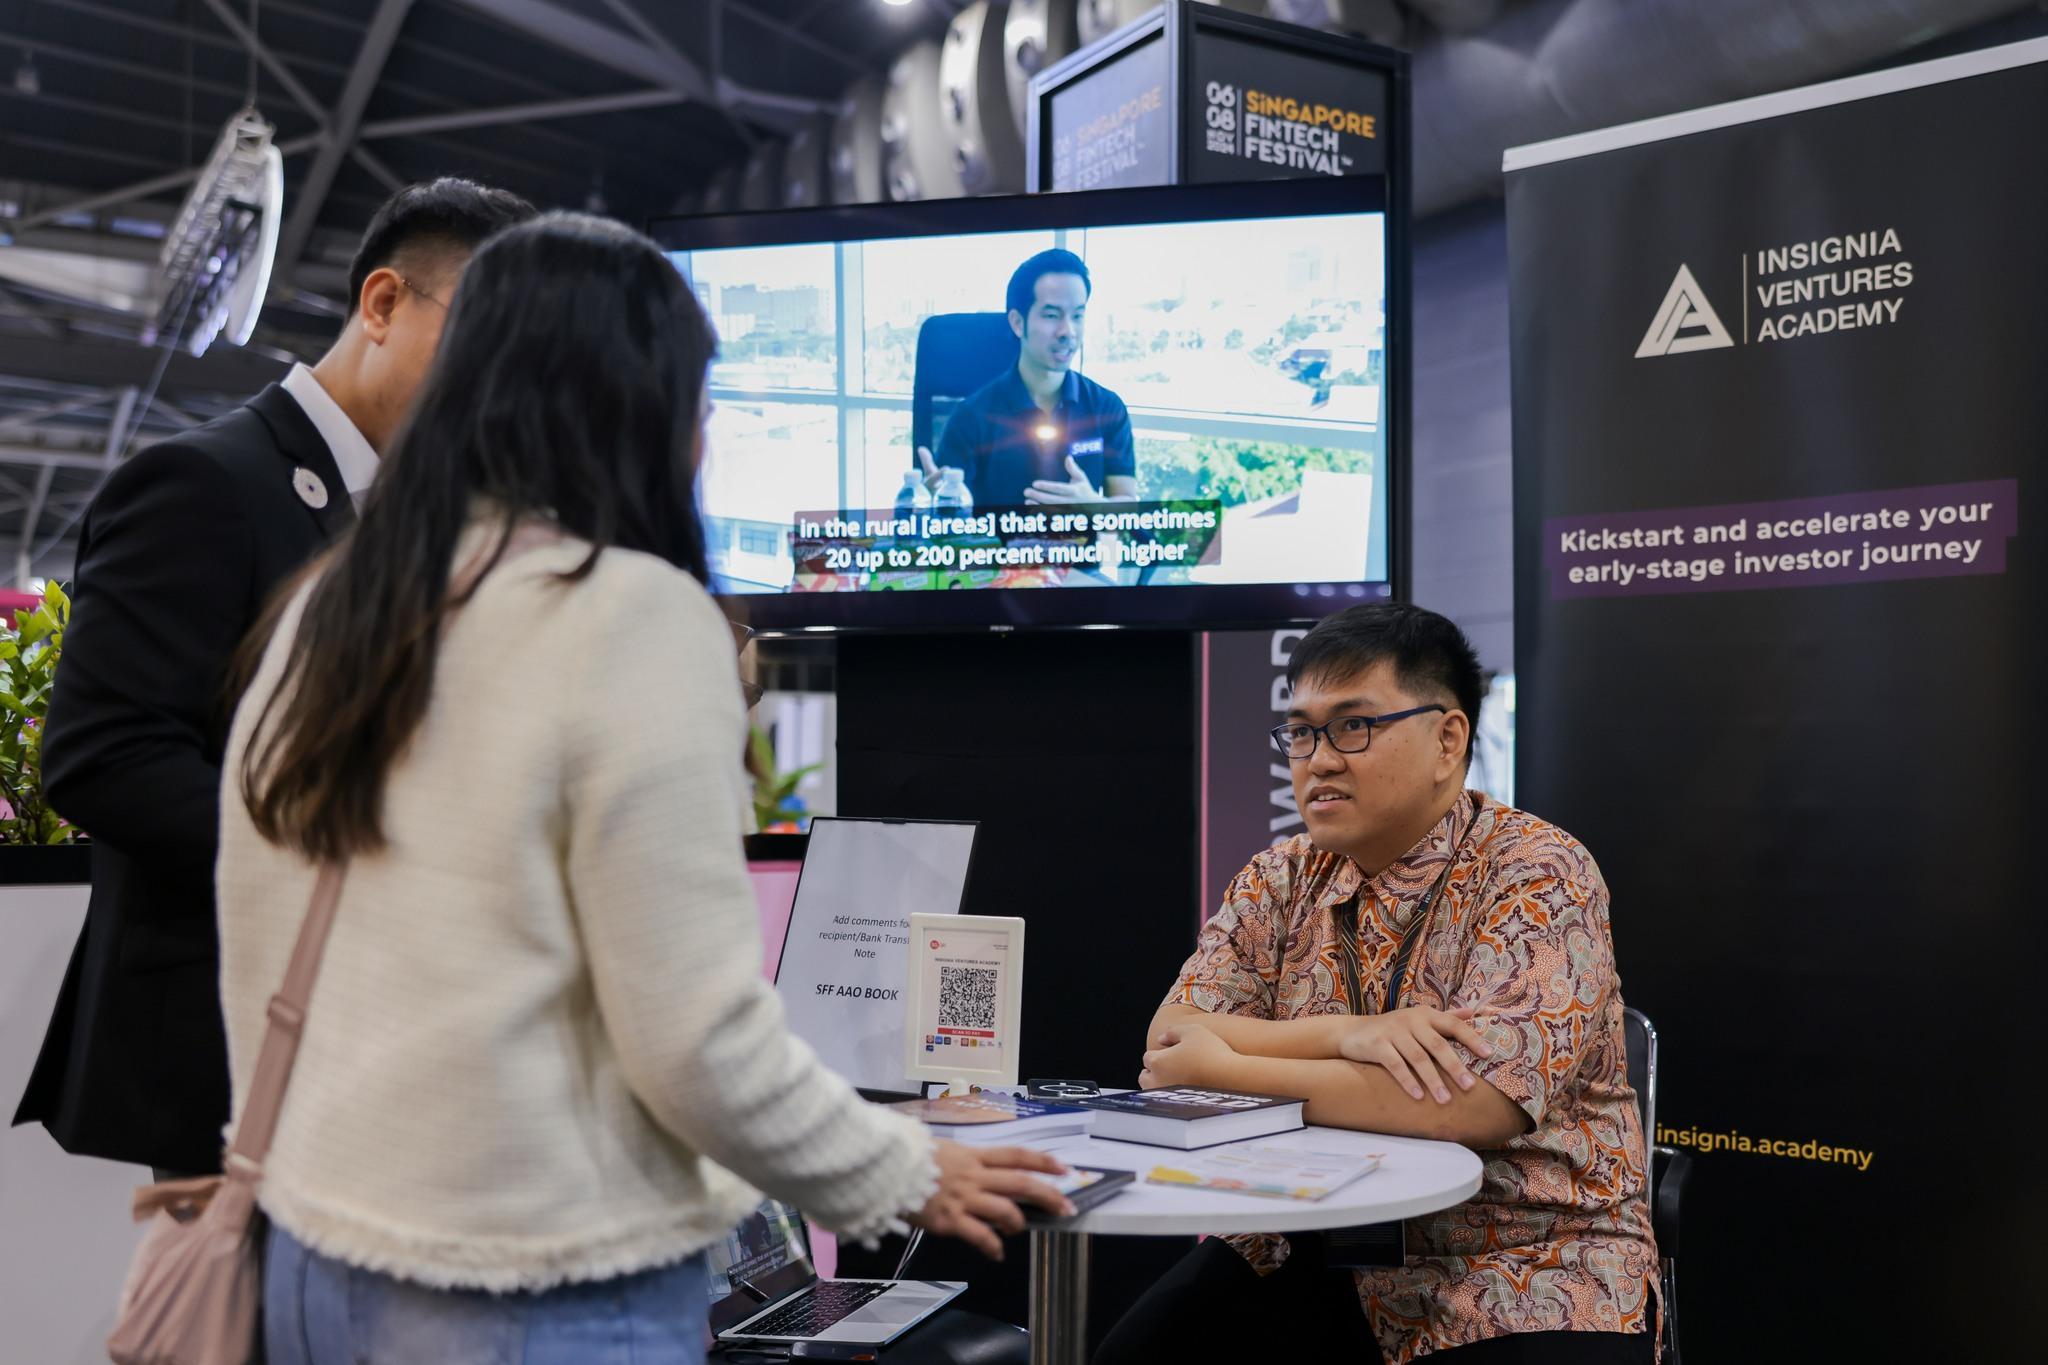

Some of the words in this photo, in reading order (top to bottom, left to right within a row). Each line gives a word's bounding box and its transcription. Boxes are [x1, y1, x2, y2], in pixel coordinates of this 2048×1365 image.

[1206, 81, 1236, 108] 06
[1206, 105, 1236, 131] 08
[1245, 112, 1339, 153] FINTECH
[1758, 228, 1902, 275] INSIGNIA
[1757, 262, 1914, 308] VENTURES
[1757, 298, 1904, 343] ACADEMY
[825, 517, 860, 537] the
[865, 515, 917, 537] rural
[921, 513, 996, 539] [areas]
[1001, 511, 1047, 533] that
[1050, 513, 1088, 532] are
[1092, 508, 1216, 530] sometimes
[1561, 525, 1685, 552] Kickstart
[1693, 518, 1747, 543] and
[1756, 511, 1911, 539] accelerate
[1919, 502, 1993, 531] your
[825, 549, 851, 568] 20
[856, 551, 884, 572] up
[888, 549, 911, 567] to
[915, 546, 955, 567] 200
[959, 544, 1044, 570] percent
[1048, 541, 1109, 564] much
[1116, 540, 1189, 566] higher
[1568, 557, 1726, 586] early-stage
[1734, 548, 1853, 574] investor
[1859, 540, 1982, 571] journey
[833, 915, 850, 925] Add
[851, 918, 898, 928] comments
[819, 931, 882, 943] recipient/Bank
[885, 934, 910, 944] Trans
[854, 948, 876, 958] Note
[816, 984, 834, 995] SFF
[836, 985, 862, 998] AAO
[864, 987, 899, 1001] BOOK
[1136, 1090, 1260, 1108] BOLD
[1656, 1122, 1873, 1171] insignia.academy
